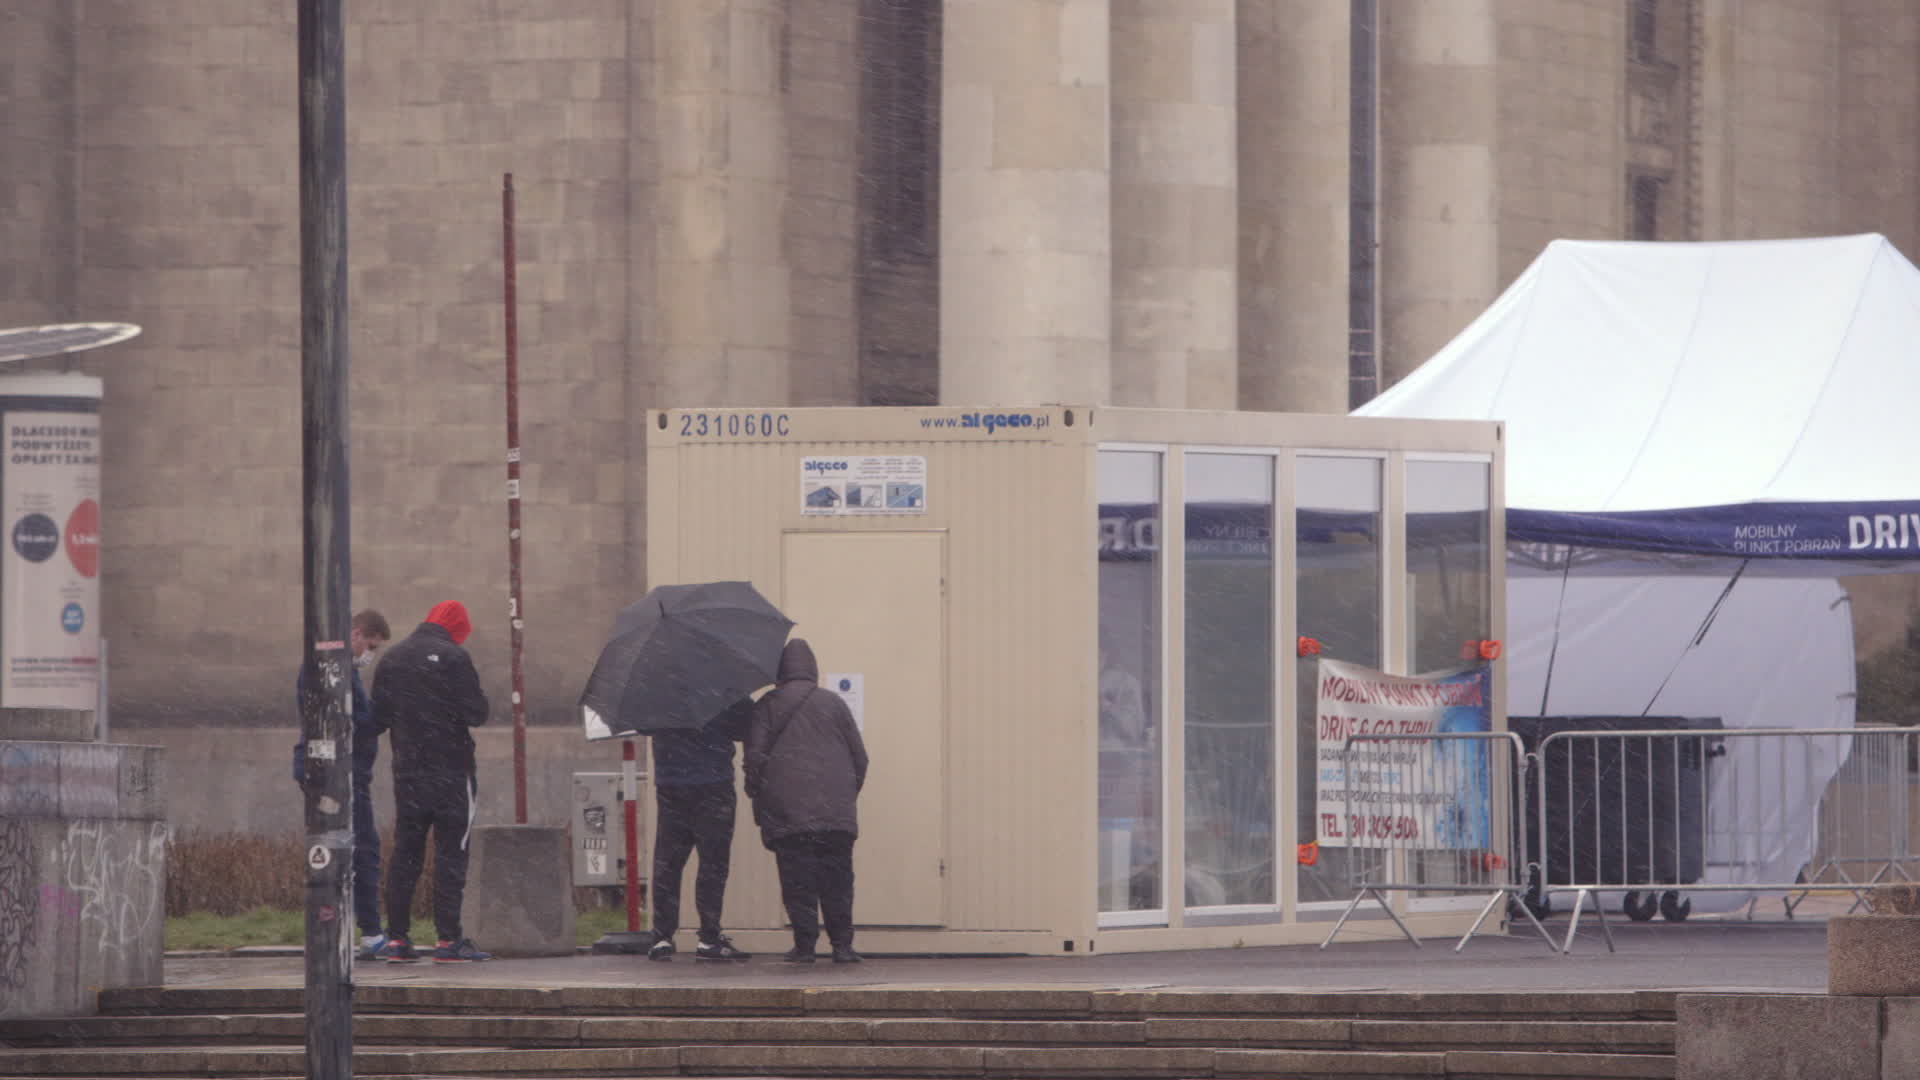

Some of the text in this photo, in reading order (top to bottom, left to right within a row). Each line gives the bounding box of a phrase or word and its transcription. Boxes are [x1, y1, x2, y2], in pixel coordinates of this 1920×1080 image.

[680, 413, 789, 437] 231060C
[1734, 524, 1797, 539] MOBILNY
[1733, 539, 1780, 554] PUNKT
[1321, 675, 1381, 705] MOBILNY
[1379, 681, 1429, 707] PUNKT
